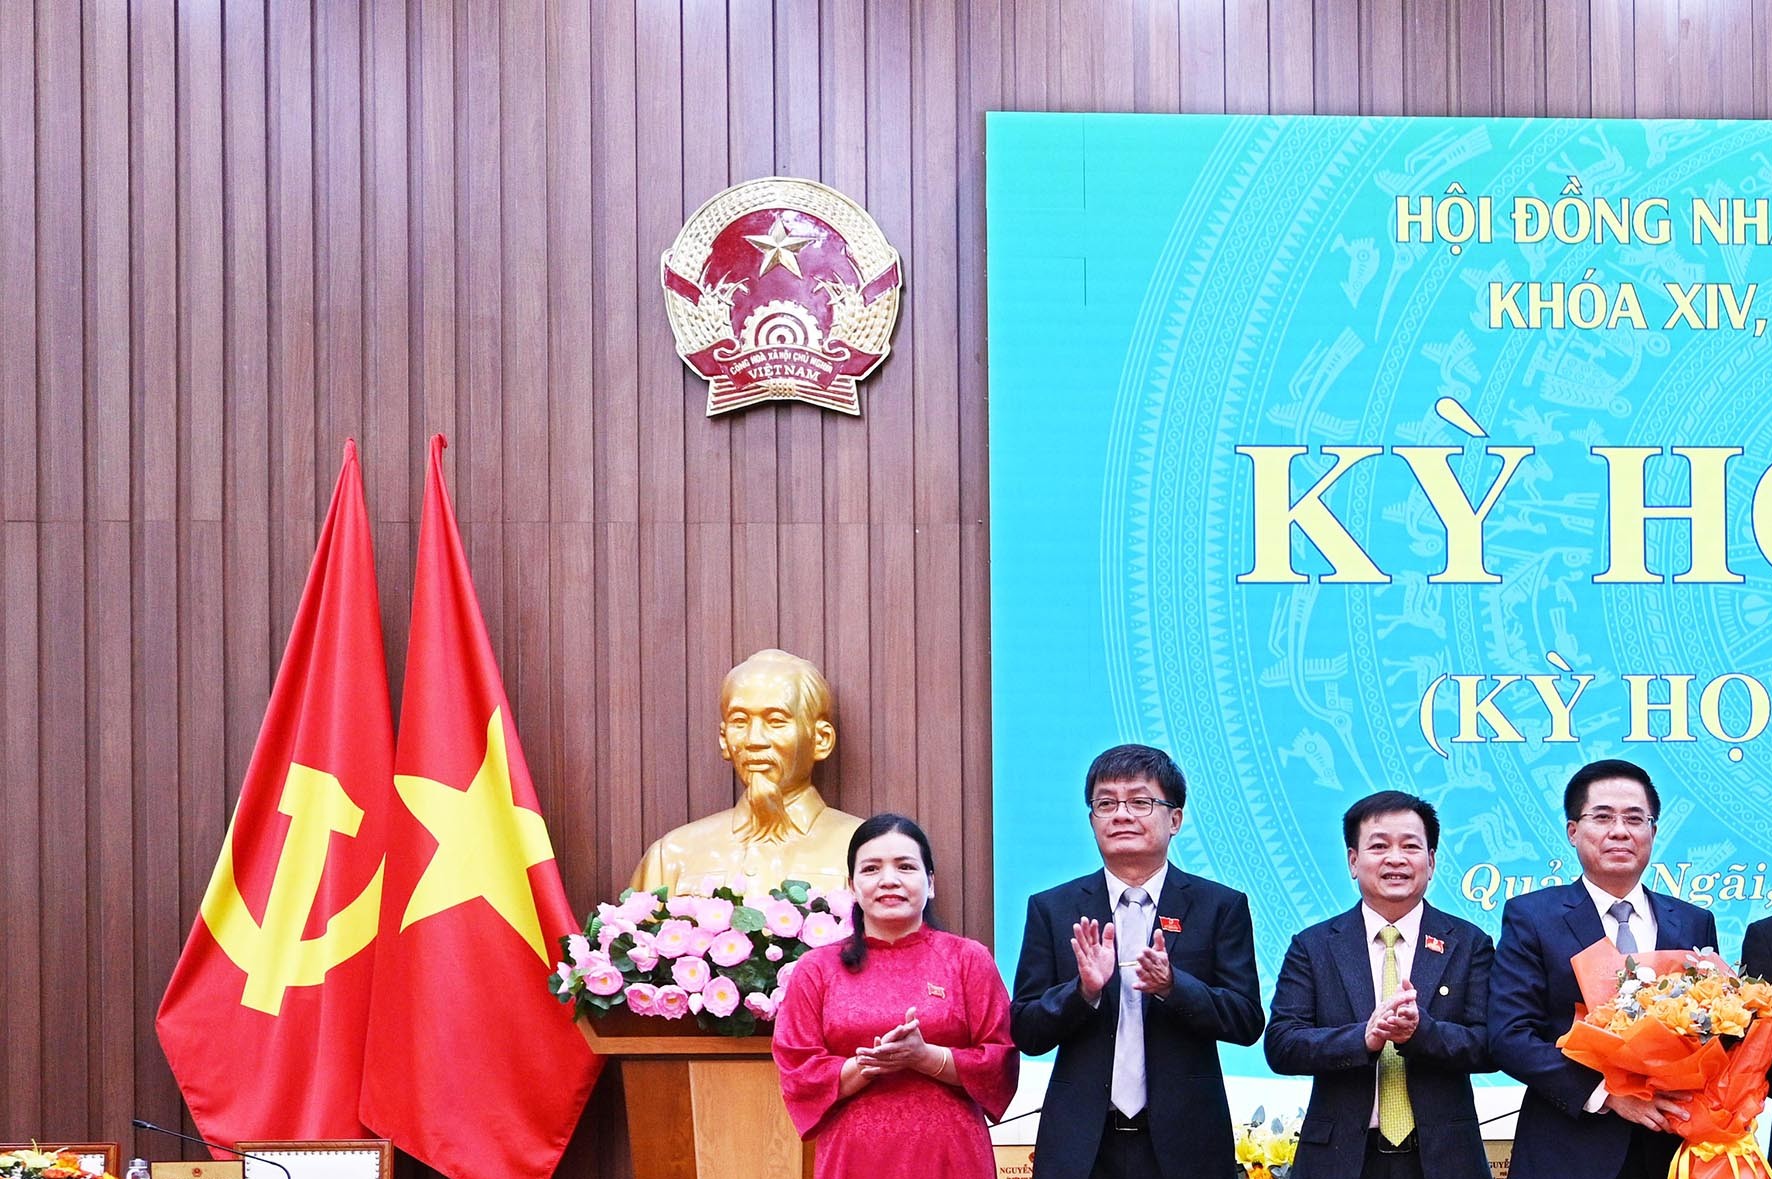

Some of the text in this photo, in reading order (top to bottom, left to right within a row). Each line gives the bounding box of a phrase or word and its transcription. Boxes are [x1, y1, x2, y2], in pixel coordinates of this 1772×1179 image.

[1395, 181, 1494, 256] HỘI
[1511, 175, 1672, 245] ĐỒNG
[1488, 268, 1648, 330] KHÓA
[1662, 283, 1768, 337] XIV,
[748, 363, 820, 382] VIỆT NAM
[1234, 397, 1535, 585] KỲ
[1418, 650, 1596, 760] (KỲ
